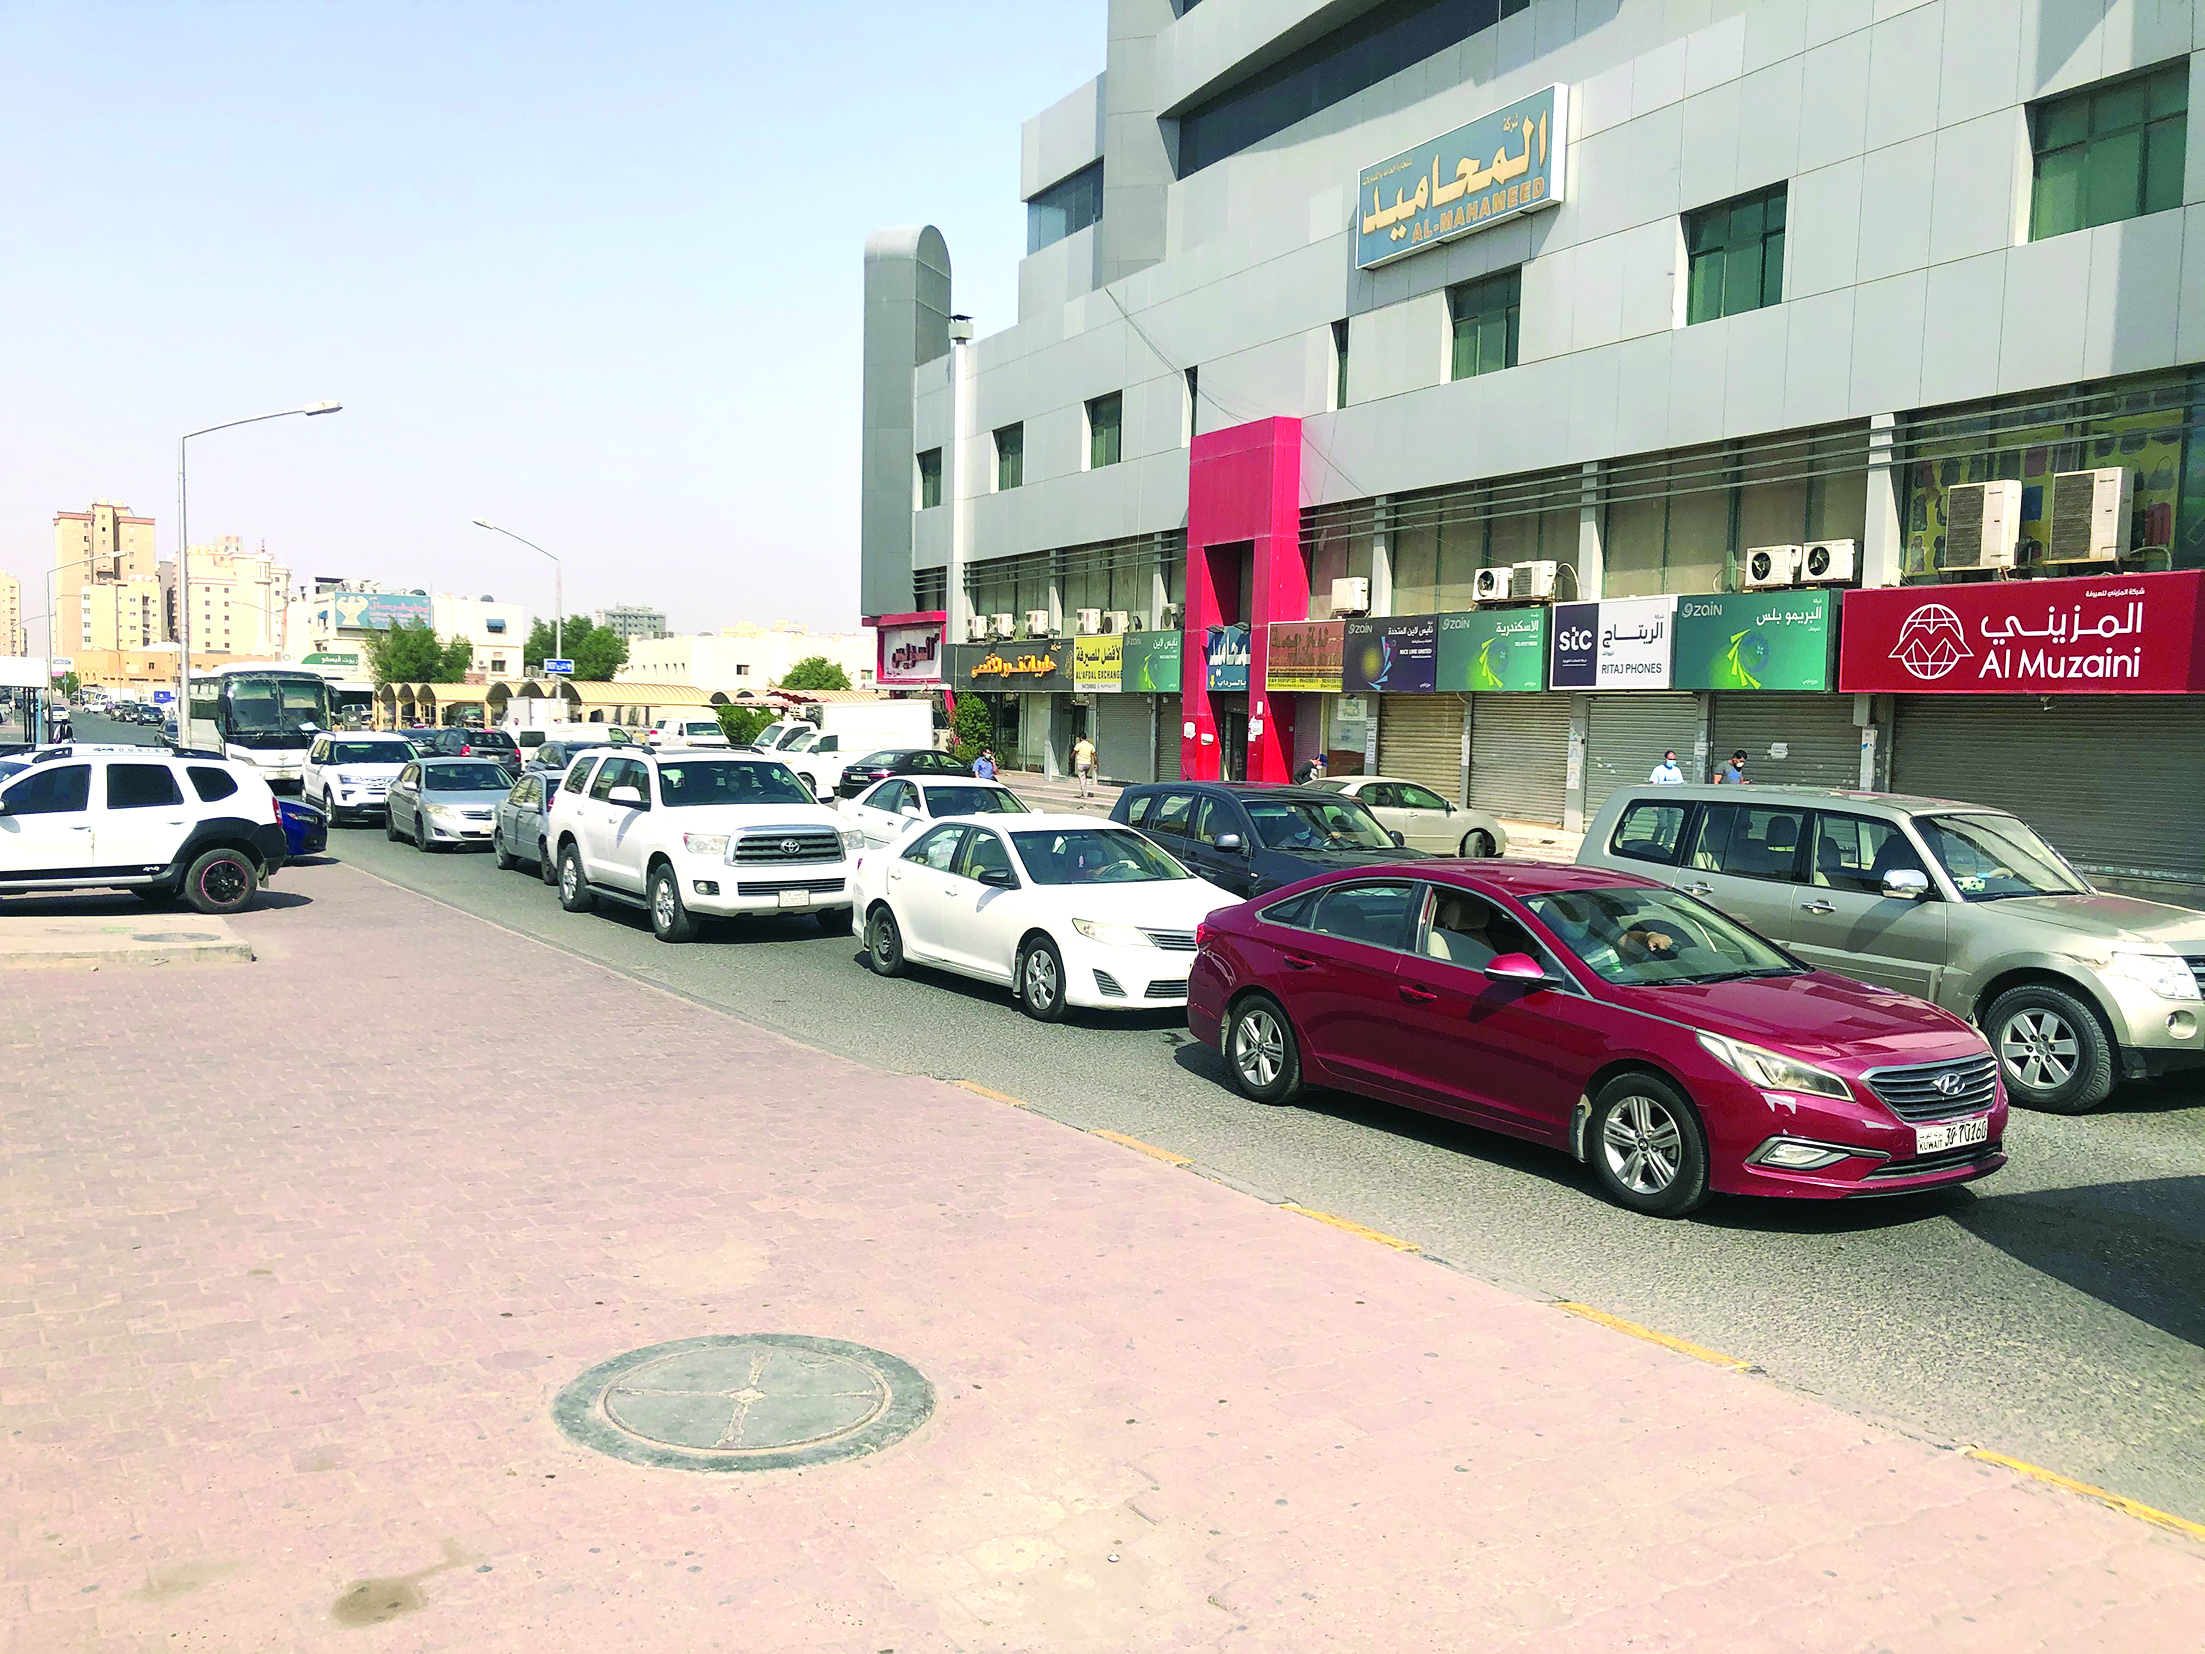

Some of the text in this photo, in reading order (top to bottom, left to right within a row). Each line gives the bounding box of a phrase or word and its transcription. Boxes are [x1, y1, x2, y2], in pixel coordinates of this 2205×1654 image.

[1502, 113, 1519, 133] شركة
[1362, 108, 1548, 242] المحاميد
[1411, 176, 1545, 243] AL-MAHAMEED
[2085, 587, 2145, 598] شركة المزيني للصيرفة
[1756, 606, 1822, 626] البريمو بلس
[1981, 602, 2144, 646] المزيني
[1388, 626, 1434, 637] نايس لاين المتحدة
[1496, 620, 1539, 637] الاسكندرية
[1559, 626, 1593, 651] stc
[1602, 621, 1664, 648] الريتاج
[1602, 663, 1662, 674] RITAJ PHONES
[1978, 646, 2142, 679] Al Muzaini
[1217, 679, 1247, 688] بالسرداب
[1919, 1140, 1943, 1151] KUWAIT
